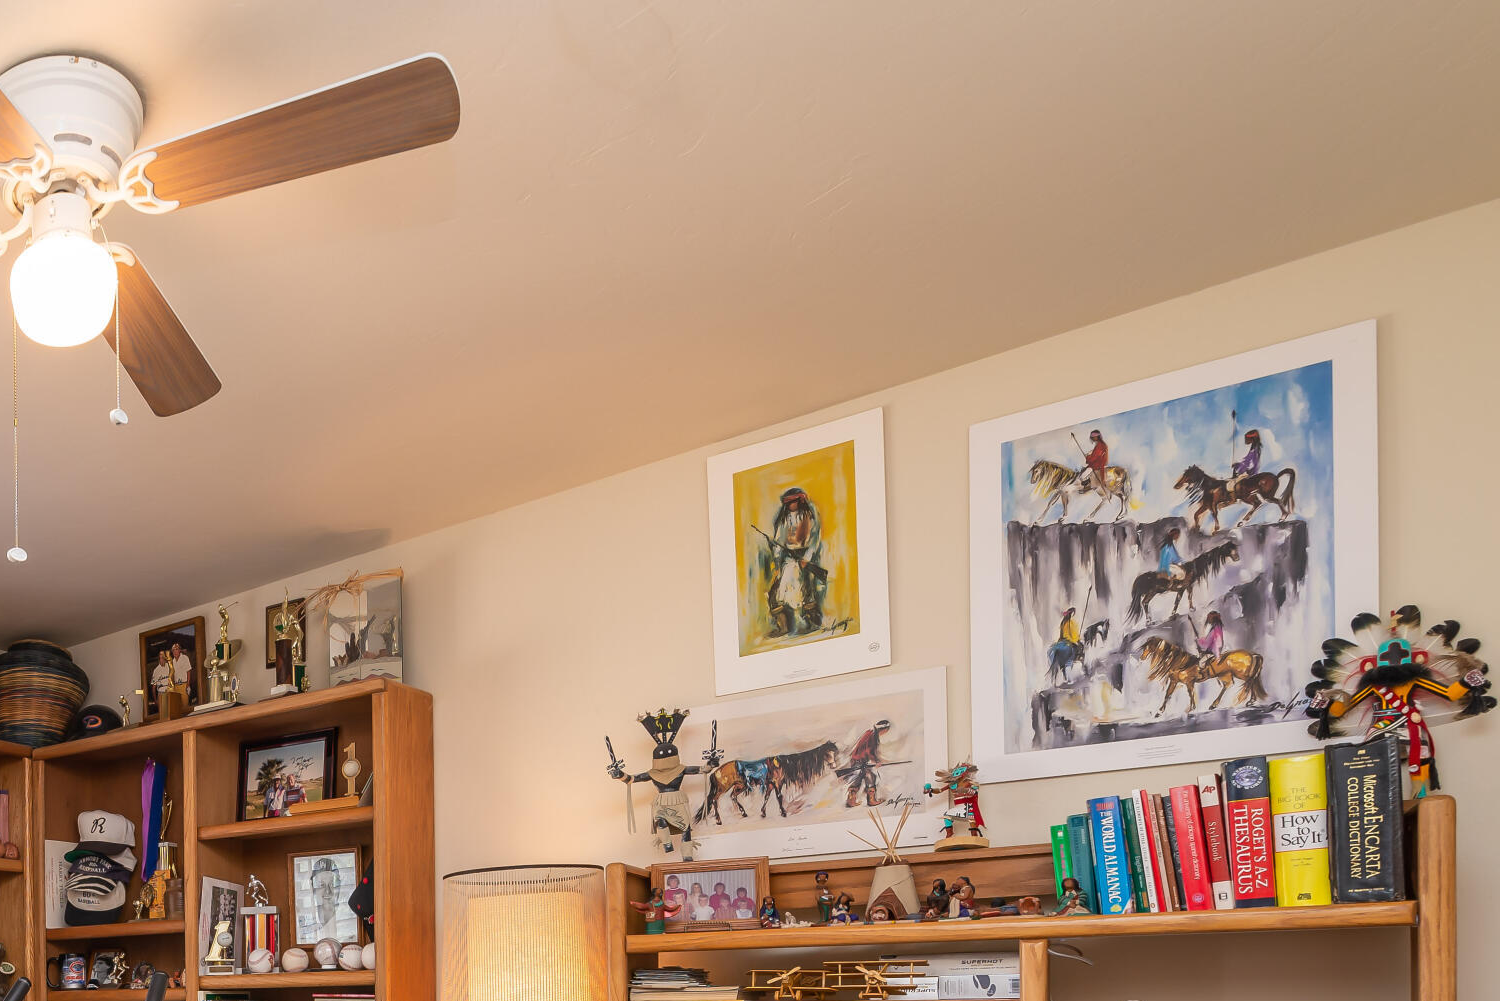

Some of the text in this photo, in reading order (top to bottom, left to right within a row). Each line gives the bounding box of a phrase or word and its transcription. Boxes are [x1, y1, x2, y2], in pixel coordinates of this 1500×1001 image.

[1202, 785, 1215, 794] AP
[1363, 774, 1379, 814] Microsoft
[90, 817, 106, 834] R
[1101, 815, 1116, 853] WORLD
[1208, 821, 1221, 861] Stylebook
[1281, 833, 1310, 848] Say
[1296, 825, 1310, 836] to
[1347, 777, 1361, 879] COLLEGE DICTIONARY
[1233, 805, 1253, 894] THESAURUS
[1251, 808, 1269, 888] ROGET'S A-Z
[1364, 815, 1383, 879] ENCARTA
[1104, 854, 1122, 904] ALMANAC
